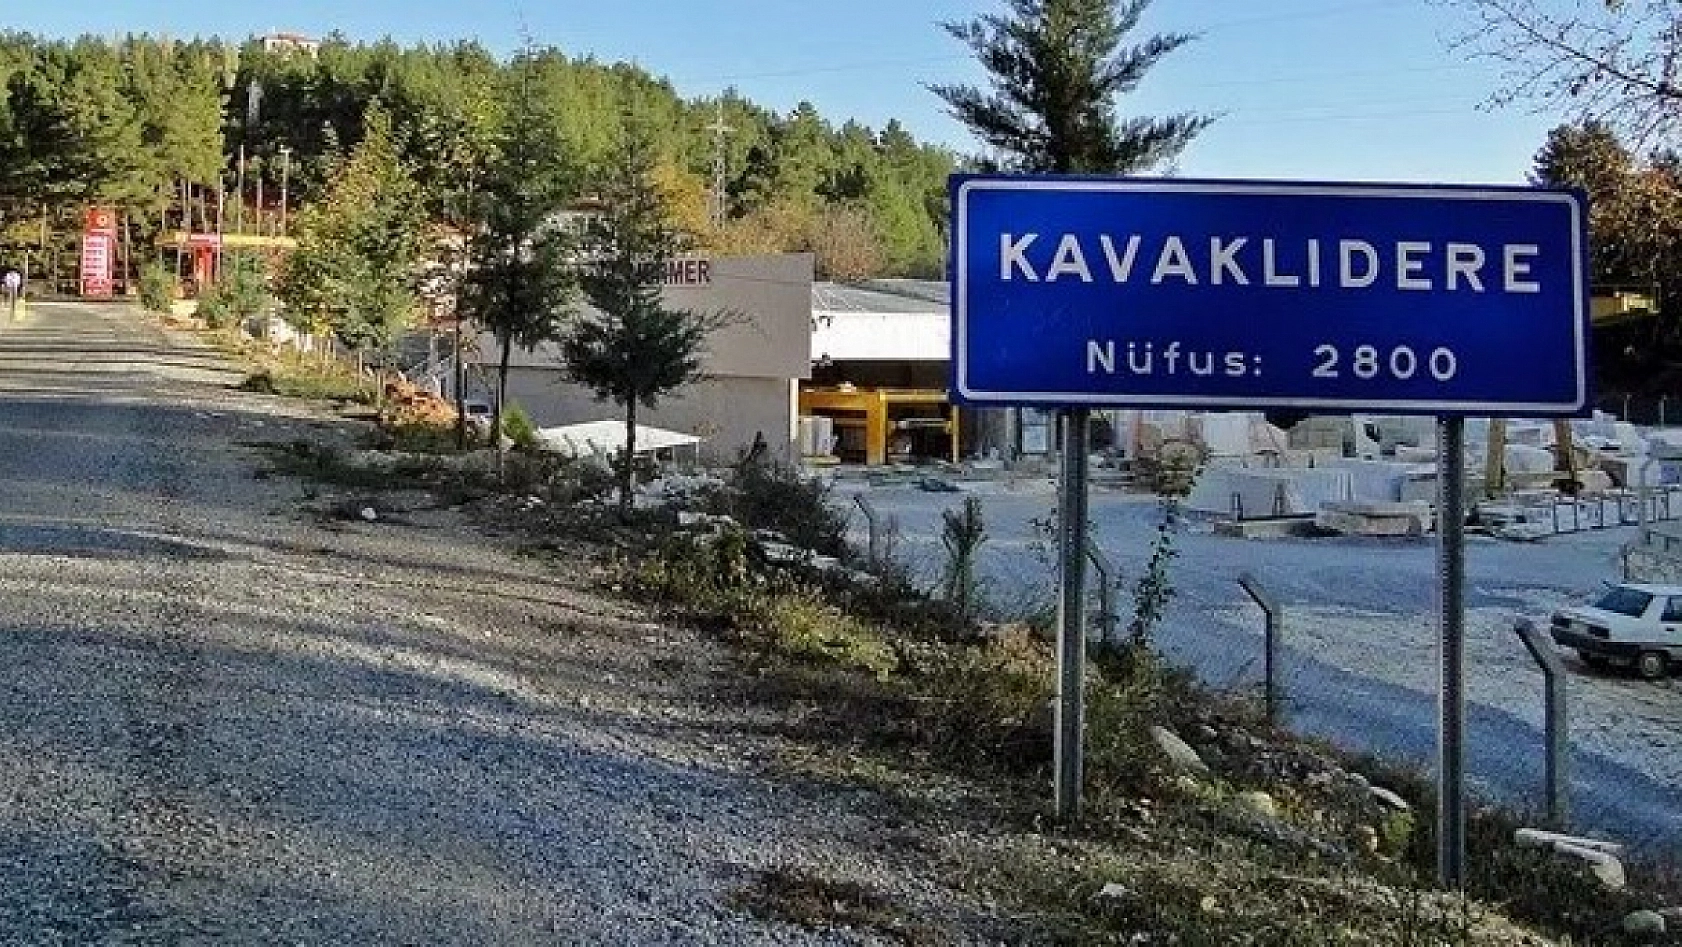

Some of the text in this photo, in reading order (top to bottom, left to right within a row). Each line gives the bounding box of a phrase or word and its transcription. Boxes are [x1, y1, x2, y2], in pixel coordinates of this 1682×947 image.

[1000, 233, 1541, 293] KAVAKLIDERE
[1087, 341, 1458, 382] Nüfus: 2800
